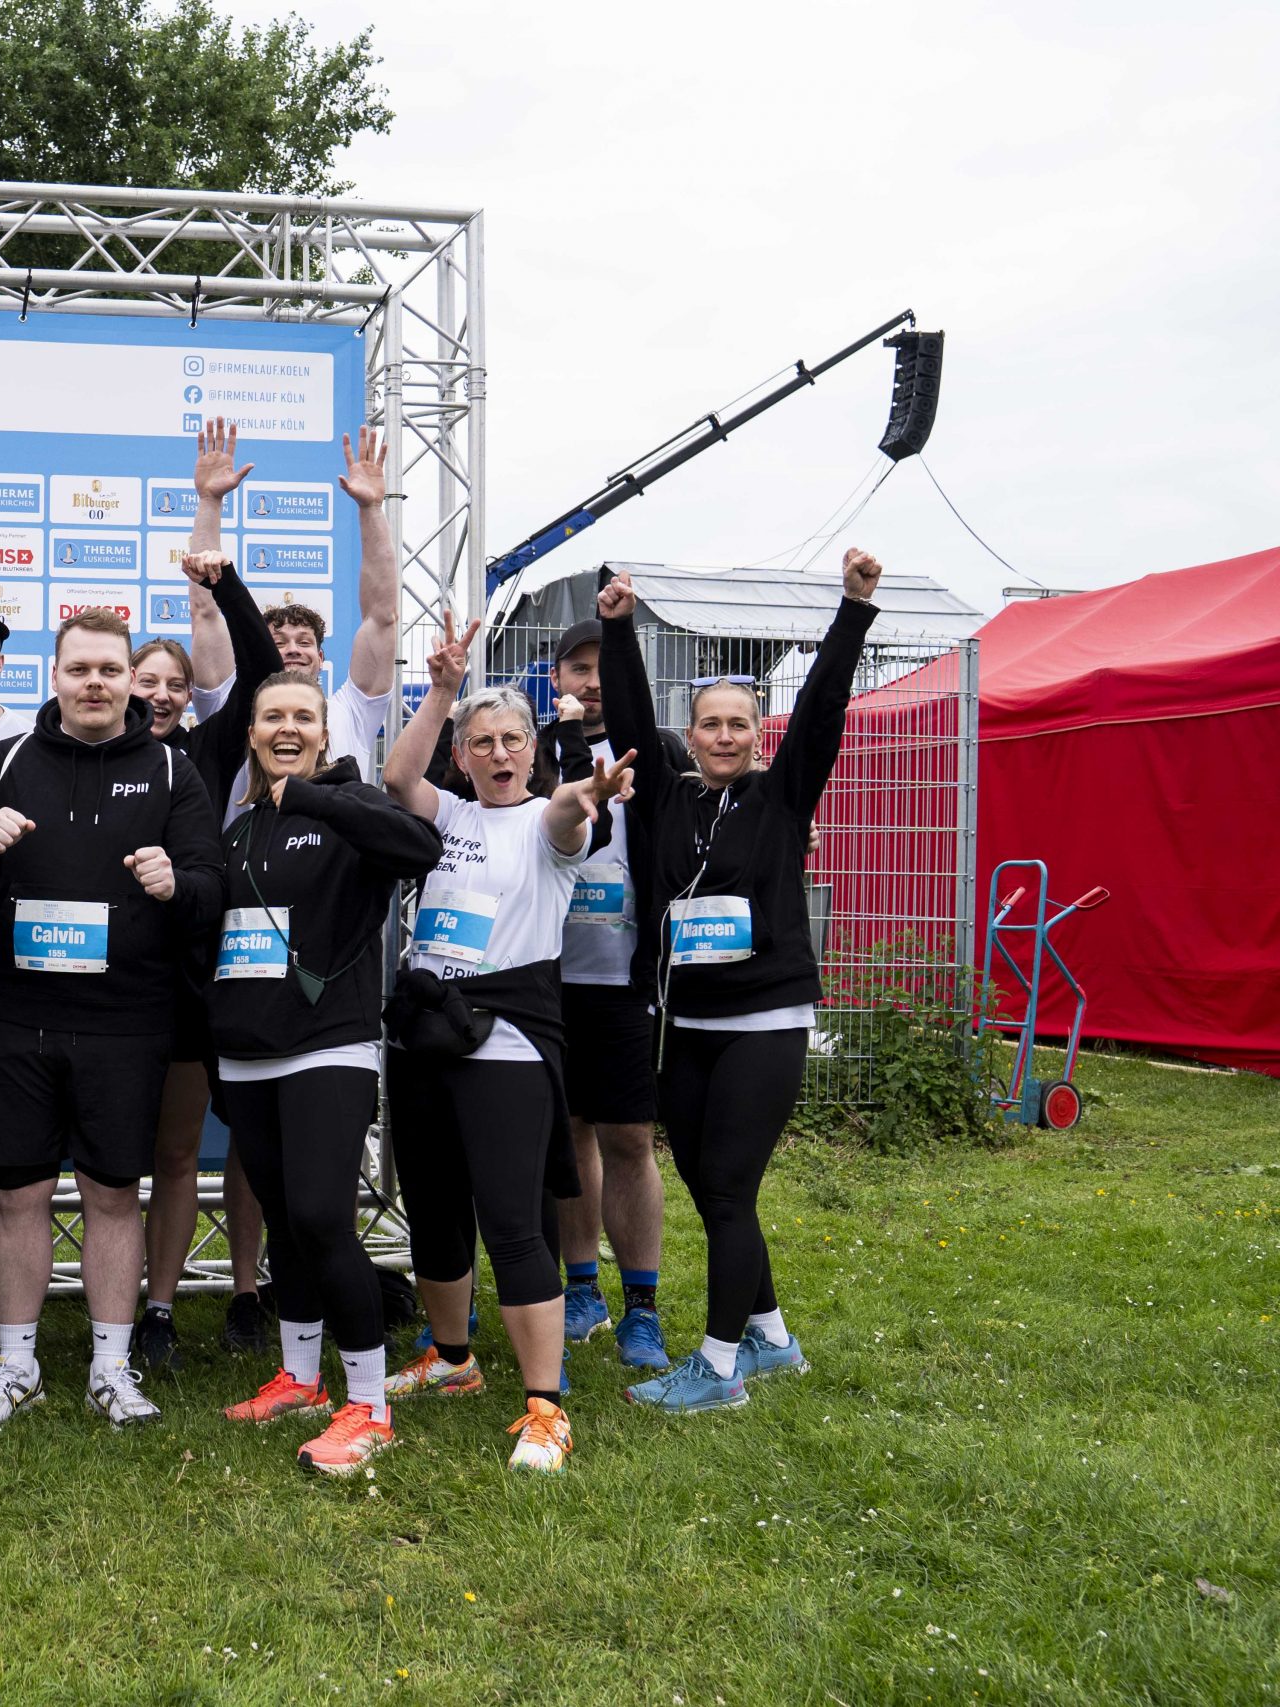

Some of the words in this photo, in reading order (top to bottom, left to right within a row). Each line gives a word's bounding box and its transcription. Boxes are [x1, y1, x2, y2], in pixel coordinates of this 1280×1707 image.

[208, 389, 278, 404] @FIRMENLAUF
[280, 391, 306, 404] KÖLN
[280, 418, 306, 431] KÖLN
[72, 493, 120, 511] Bitburger
[276, 496, 324, 507] THERME
[276, 507, 324, 515] EUSKIRCHEN
[83, 545, 132, 556] THERME
[276, 549, 324, 560] THERME
[83, 555, 133, 565] EUSKIRCHEN
[276, 560, 325, 568] EUSKIRCHEN
[572, 888, 606, 901] arco
[434, 911, 459, 930] Pia
[31, 925, 87, 945] Calvin
[682, 921, 737, 939] Mareen
[221, 932, 273, 952] Kerstin
[694, 942, 713, 951] 1562
[47, 949, 68, 959] 1555
